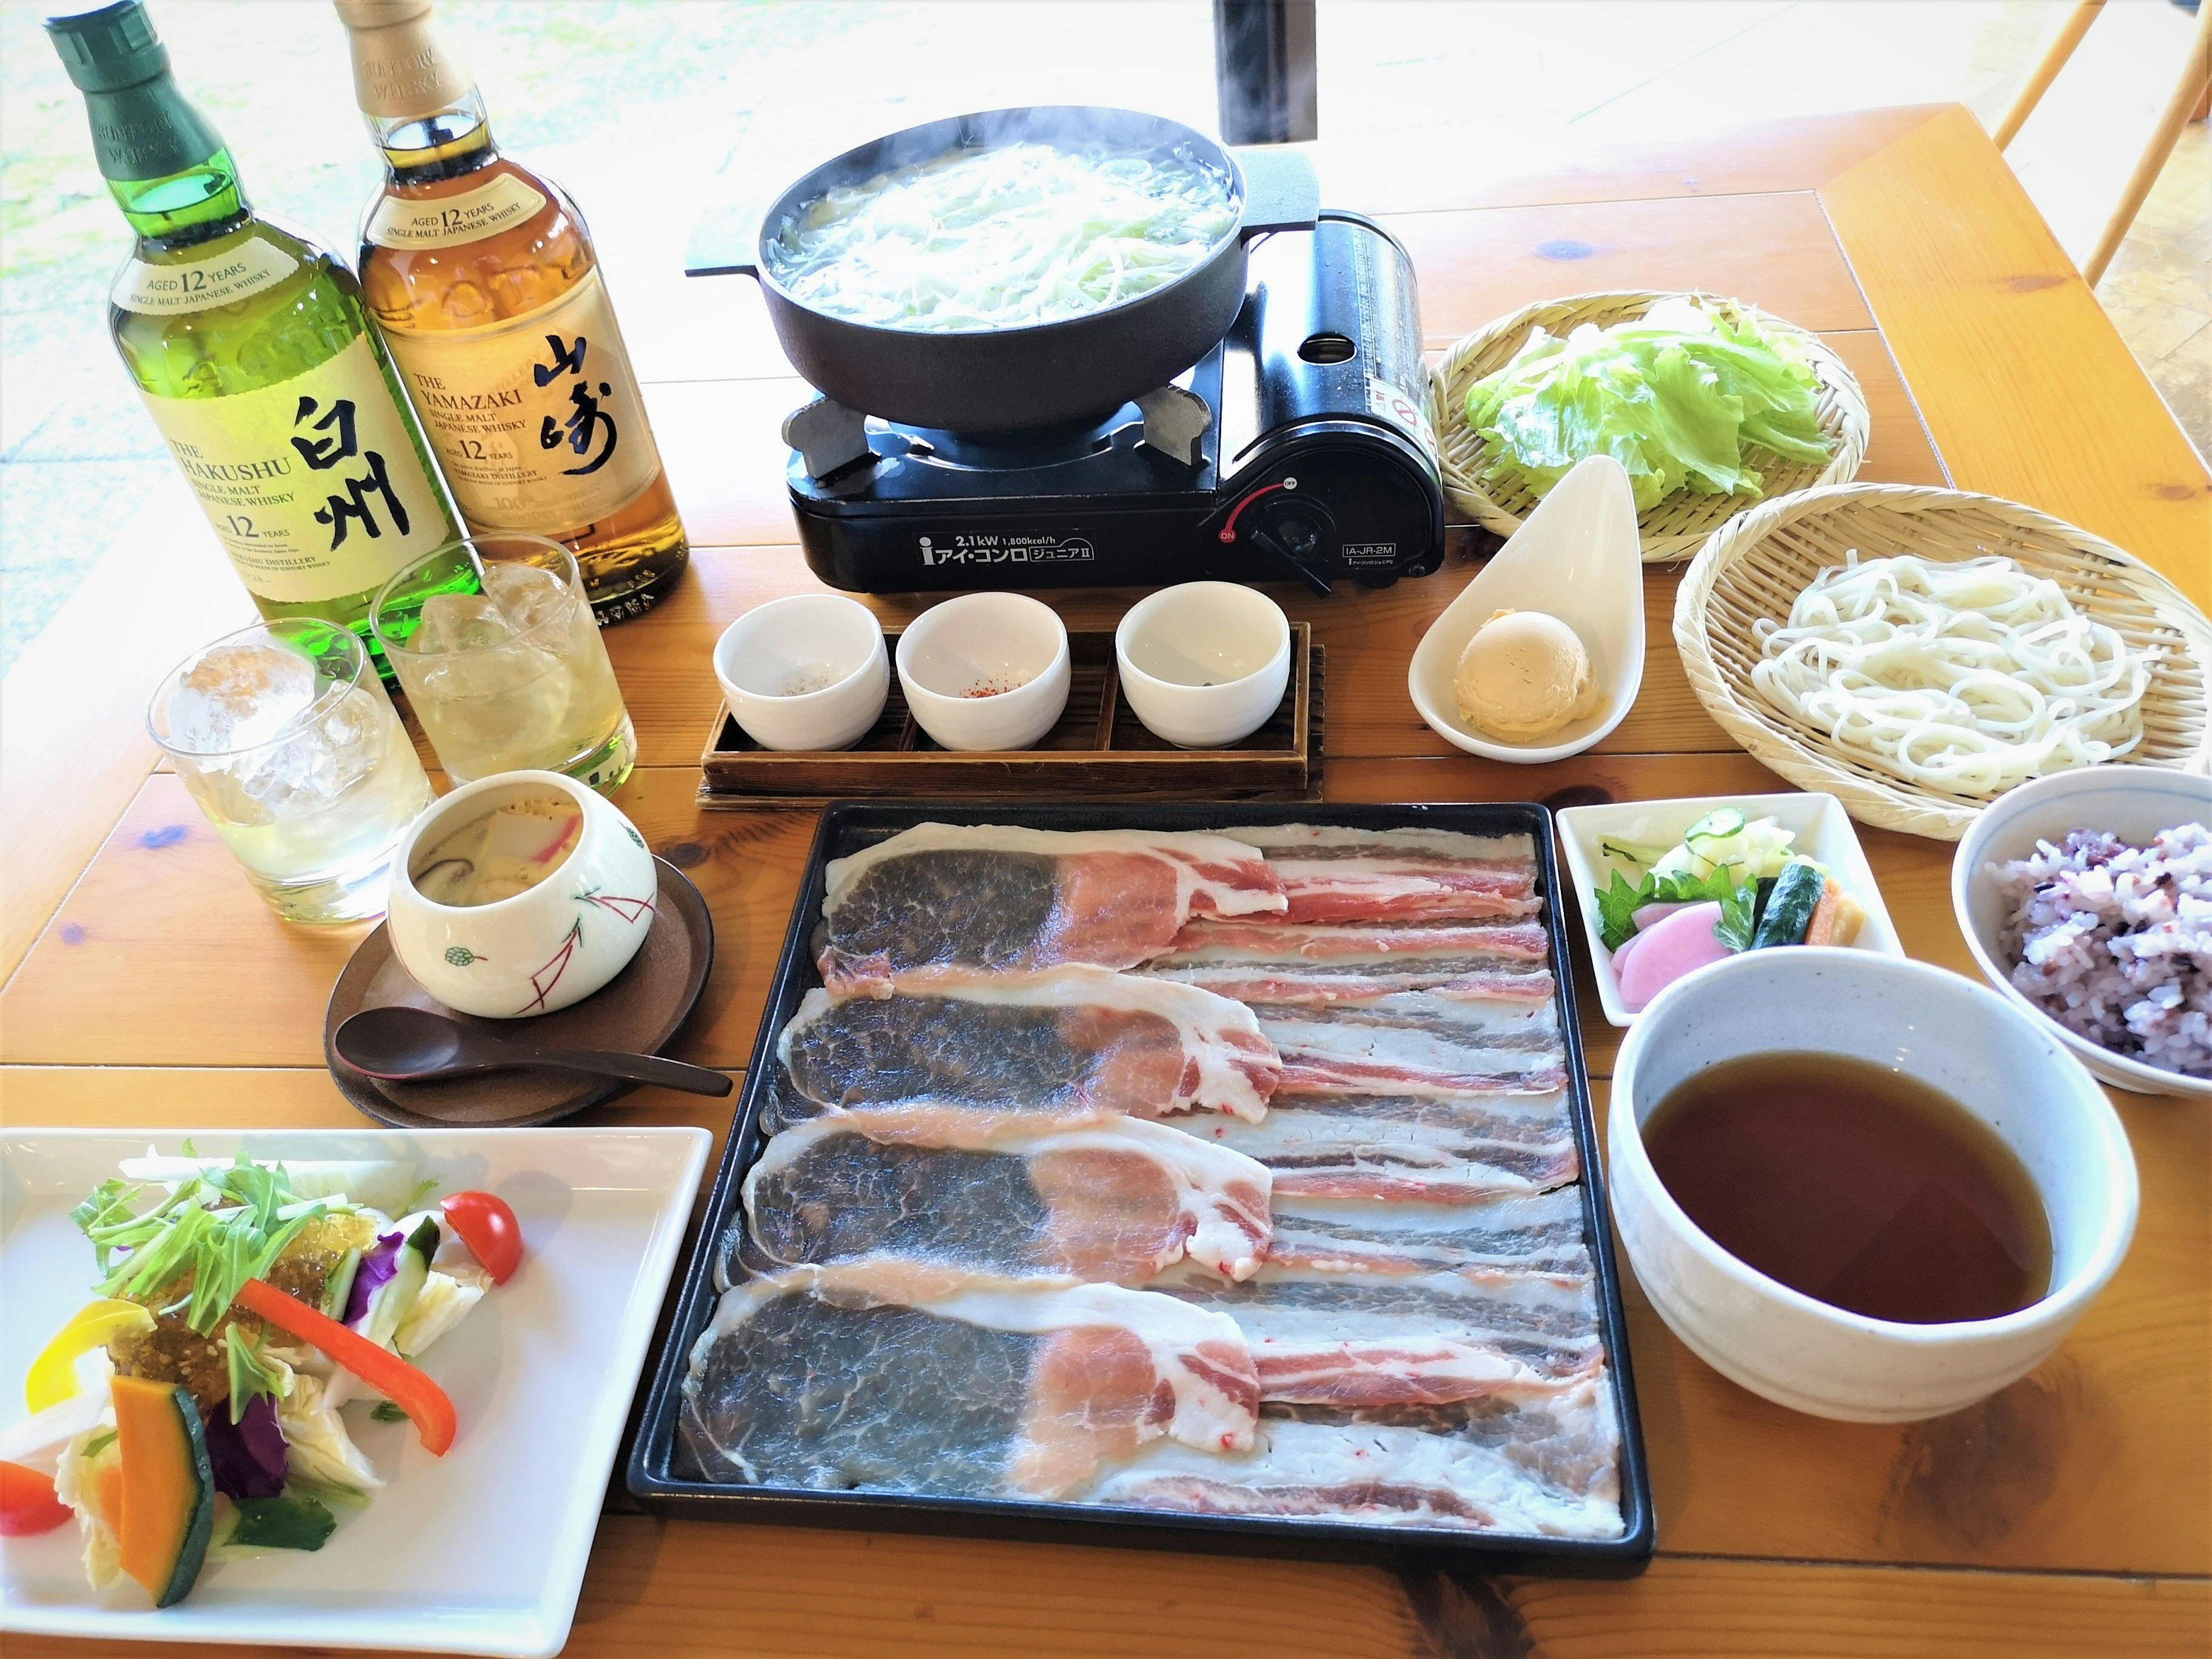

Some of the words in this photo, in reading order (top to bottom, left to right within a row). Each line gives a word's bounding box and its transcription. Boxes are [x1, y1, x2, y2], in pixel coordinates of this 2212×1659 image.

[386, 227, 414, 238] SINGLE
[415, 228, 439, 238] MALT
[442, 218, 489, 236] JAPANESE
[488, 202, 521, 223] WHISKY
[411, 216, 438, 226] AGED
[440, 208, 463, 227] 12
[463, 203, 495, 219] YEARS
[130, 293, 156, 305] SINGLE
[156, 297, 182, 306] MALT
[184, 286, 233, 304] JAPANESE
[233, 268, 271, 290] WHISKY
[147, 280, 178, 290] AGED
[180, 270, 207, 292] 12
[207, 263, 247, 283] YEARS
[414, 373, 446, 390] THE
[420, 388, 523, 411] YAMAZAKI
[429, 409, 463, 422] SINGLE
[465, 412, 497, 423] MALT
[434, 420, 481, 433] JAPANESE
[481, 419, 526, 433] WHISKY
[170, 438, 204, 458] THE
[446, 447, 463, 457] AGED
[458, 439, 487, 460] 12
[488, 452, 514, 460] YEARS
[179, 457, 292, 481] HAKUSHU
[290, 396, 411, 552] 白州
[491, 470, 537, 480] DISTILLERY
[190, 478, 226, 494] SINGLE
[227, 485, 261, 495] MALT
[198, 489, 246, 506] JAPANESE
[245, 492, 295, 506] WHISKY
[226, 514, 260, 538] 12
[261, 529, 290, 538] YEARS
[1002, 536, 1056, 546] 1,800kcal/h
[1346, 546, 1392, 555] IA-JR-2M
[265, 555, 316, 566] DISTILLERY
